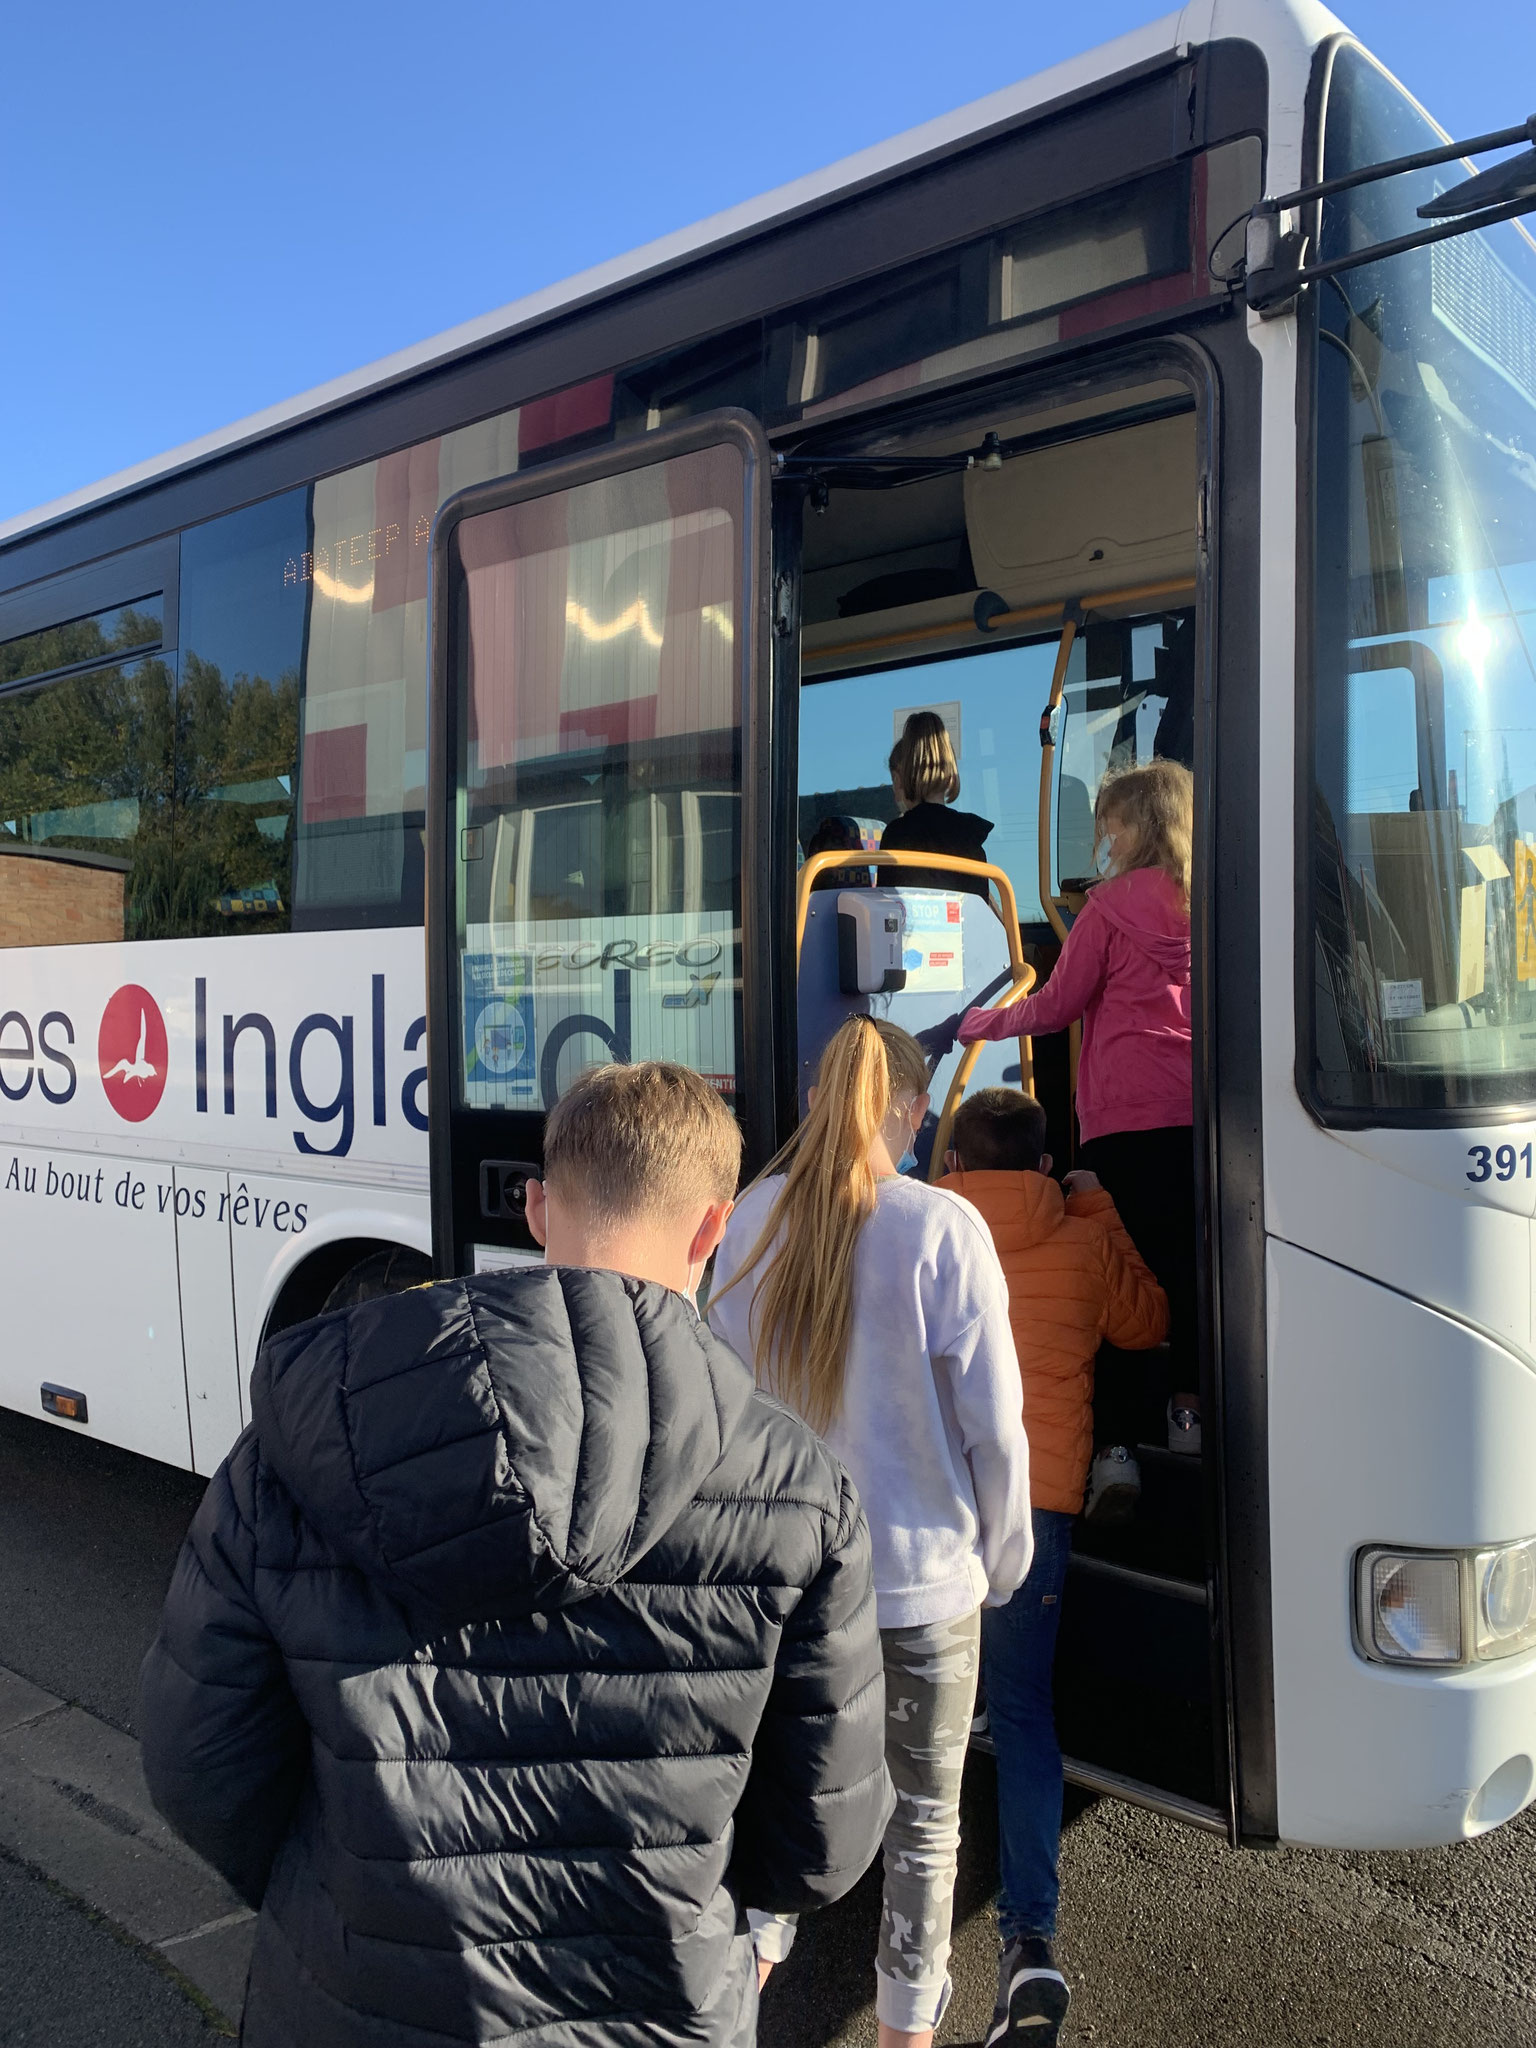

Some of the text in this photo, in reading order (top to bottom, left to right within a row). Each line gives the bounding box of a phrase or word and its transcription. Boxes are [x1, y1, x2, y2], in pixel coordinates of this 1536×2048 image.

[283, 510, 438, 587] ADATEEP A
[911, 904, 939, 918] STOP
[532, 937, 723, 971] ECREO
[0, 1010, 77, 1105] es
[1465, 1142, 1532, 1183] 391
[5, 1157, 309, 1234] Au bout de vos rêves
